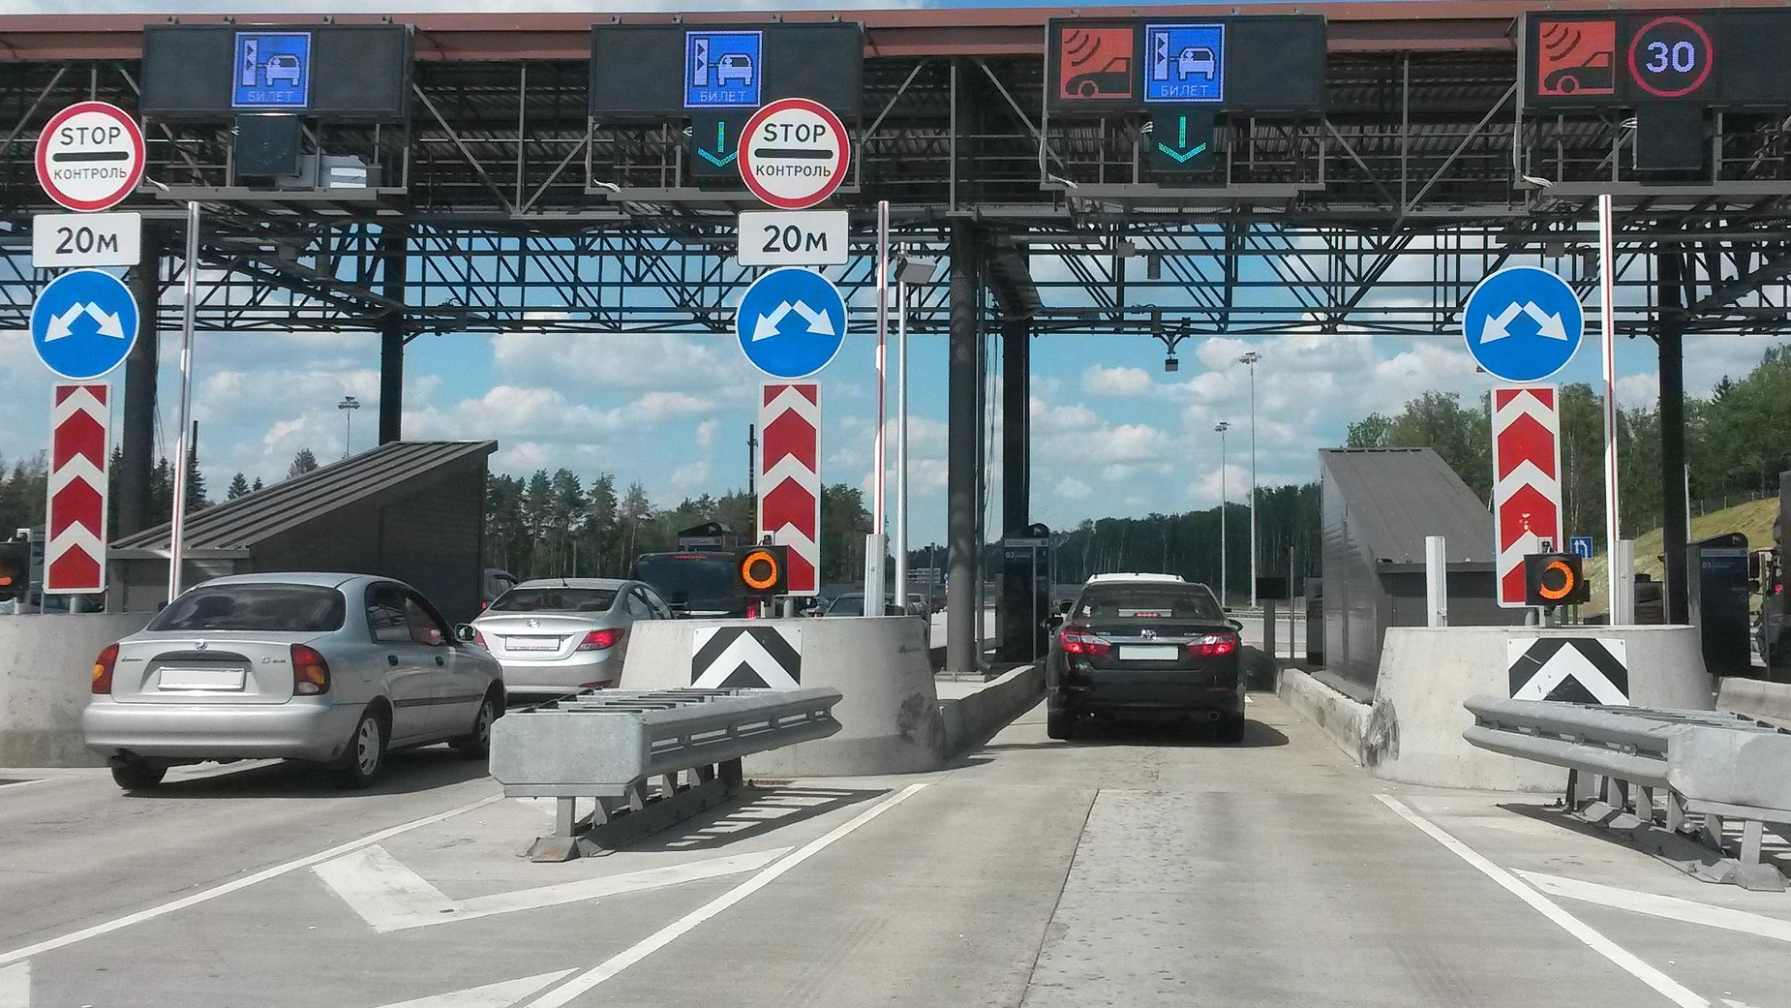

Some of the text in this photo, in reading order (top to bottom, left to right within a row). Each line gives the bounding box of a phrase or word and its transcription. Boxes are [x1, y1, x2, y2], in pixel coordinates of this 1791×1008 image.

[1646, 41, 1694, 72] 30
[248, 91, 293, 102] БИЛЕТ
[700, 91, 747, 102] БИЛЕТ
[1161, 85, 1209, 96] БИЛЕТ
[60, 126, 121, 145] STOP
[763, 123, 826, 143] STOP
[54, 167, 128, 180] КОНТРОЛЬ
[756, 164, 831, 177] КОНТРОЛЬ
